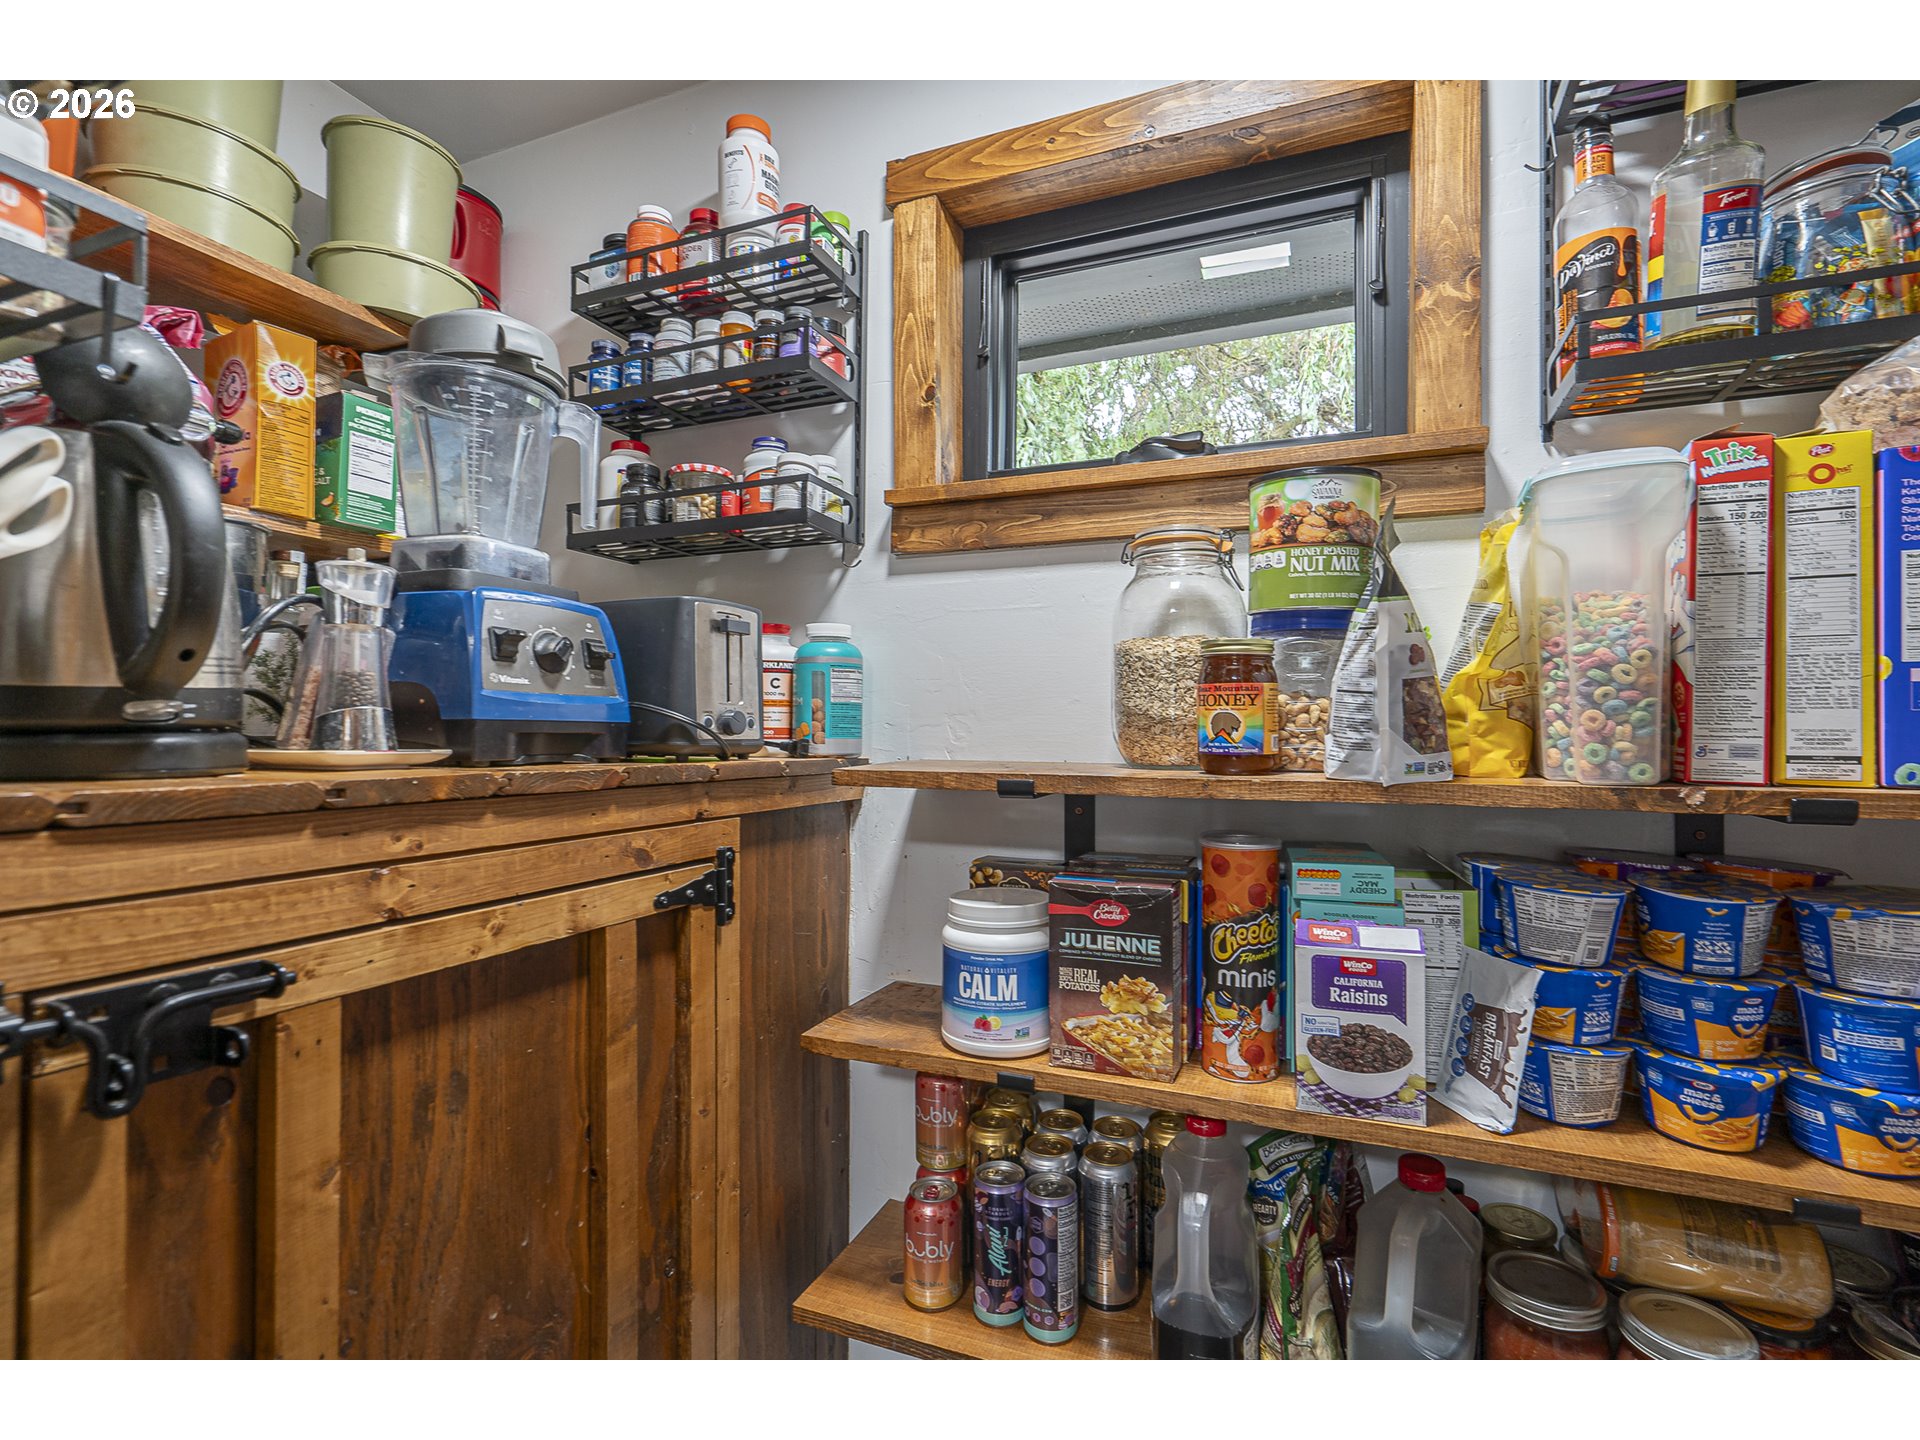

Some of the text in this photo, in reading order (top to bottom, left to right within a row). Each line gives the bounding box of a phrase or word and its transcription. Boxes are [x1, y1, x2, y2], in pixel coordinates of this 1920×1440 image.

[1704, 241, 1737, 252] Nutrition
[1559, 243, 1616, 290] DaVinci
[1702, 266, 1736, 275] Calories
[1702, 442, 1757, 467] Trix
[1730, 512, 1746, 520] 150
[1750, 510, 1767, 518] 220
[1839, 510, 1856, 518] 160
[1290, 546, 1360, 556] HONEY ROASTED
[1290, 556, 1360, 572] NUT MIX
[770, 678, 780, 688] C
[1200, 694, 1259, 706] HONEY
[1100, 903, 1121, 913] Betty
[1094, 910, 1127, 920] Crocker
[1313, 928, 1348, 938] WinCo
[1059, 932, 1162, 956] JULIENNE
[1214, 918, 1278, 961] Cheetos
[960, 964, 983, 973] NATURAL
[1343, 960, 1372, 970] WinCo
[1074, 968, 1100, 984] REAL
[1218, 968, 1276, 988] minis
[958, 971, 1018, 1002] CALM
[1058, 981, 1100, 992] POTATOES
[1334, 976, 1384, 989] CALIFORNIA
[1329, 986, 1388, 1006] Raisins
[1736, 1006, 1755, 1014] mac
[1304, 1016, 1317, 1026] NO
[1478, 1012, 1497, 1080] BREAKFAST
[1683, 1088, 1722, 1104] mac &
[1884, 1117, 1912, 1126] mac
[1253, 1204, 1277, 1215] HEARTY
[906, 1232, 954, 1262] bubly
[986, 1224, 1012, 1276] Alani
[988, 1278, 1010, 1288] ENERGY
